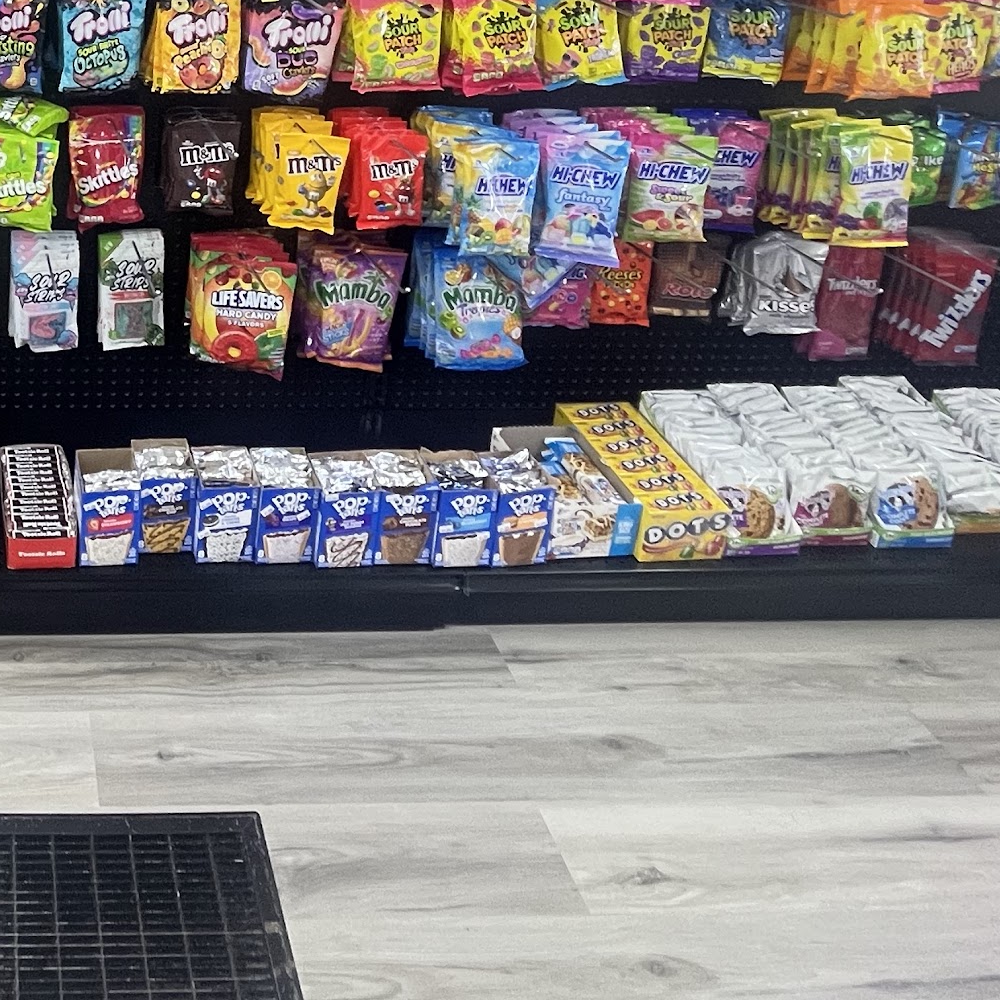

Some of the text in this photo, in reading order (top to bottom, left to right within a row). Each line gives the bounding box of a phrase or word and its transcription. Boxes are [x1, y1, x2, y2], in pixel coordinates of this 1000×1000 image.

[70, 1, 131, 43] Trolli
[168, 4, 227, 44] Trolli
[654, 18, 691, 31] SOUR
[728, 10, 774, 24] SOUR
[264, 14, 332, 48] Trolli
[384, 23, 419, 36] SOUR
[484, 20, 521, 35] SOUR
[729, 23, 777, 38] PATCH
[384, 36, 422, 50] PATCH
[486, 31, 527, 46] PATCH
[653, 30, 693, 42] PATCH
[73, 44, 127, 74] OCTOPUS
[78, 163, 139, 196] Skittles
[551, 164, 621, 190] HI-CHEW
[638, 162, 711, 184] HI-CHEW
[850, 162, 909, 184] HI-CHEW
[557, 187, 611, 209] fantasy
[313, 281, 392, 309] Mamba
[443, 287, 518, 312] Mamba
[215, 309, 277, 321] HARD CANDY
[918, 269, 992, 348] Twizzlers
[234, 320, 264, 329] FLAVORS
[577, 404, 619, 419] DOTS
[591, 420, 634, 436] DOTS
[606, 437, 649, 453] DOTS
[621, 455, 666, 470] DOTS
[643, 513, 731, 545] DOTS
